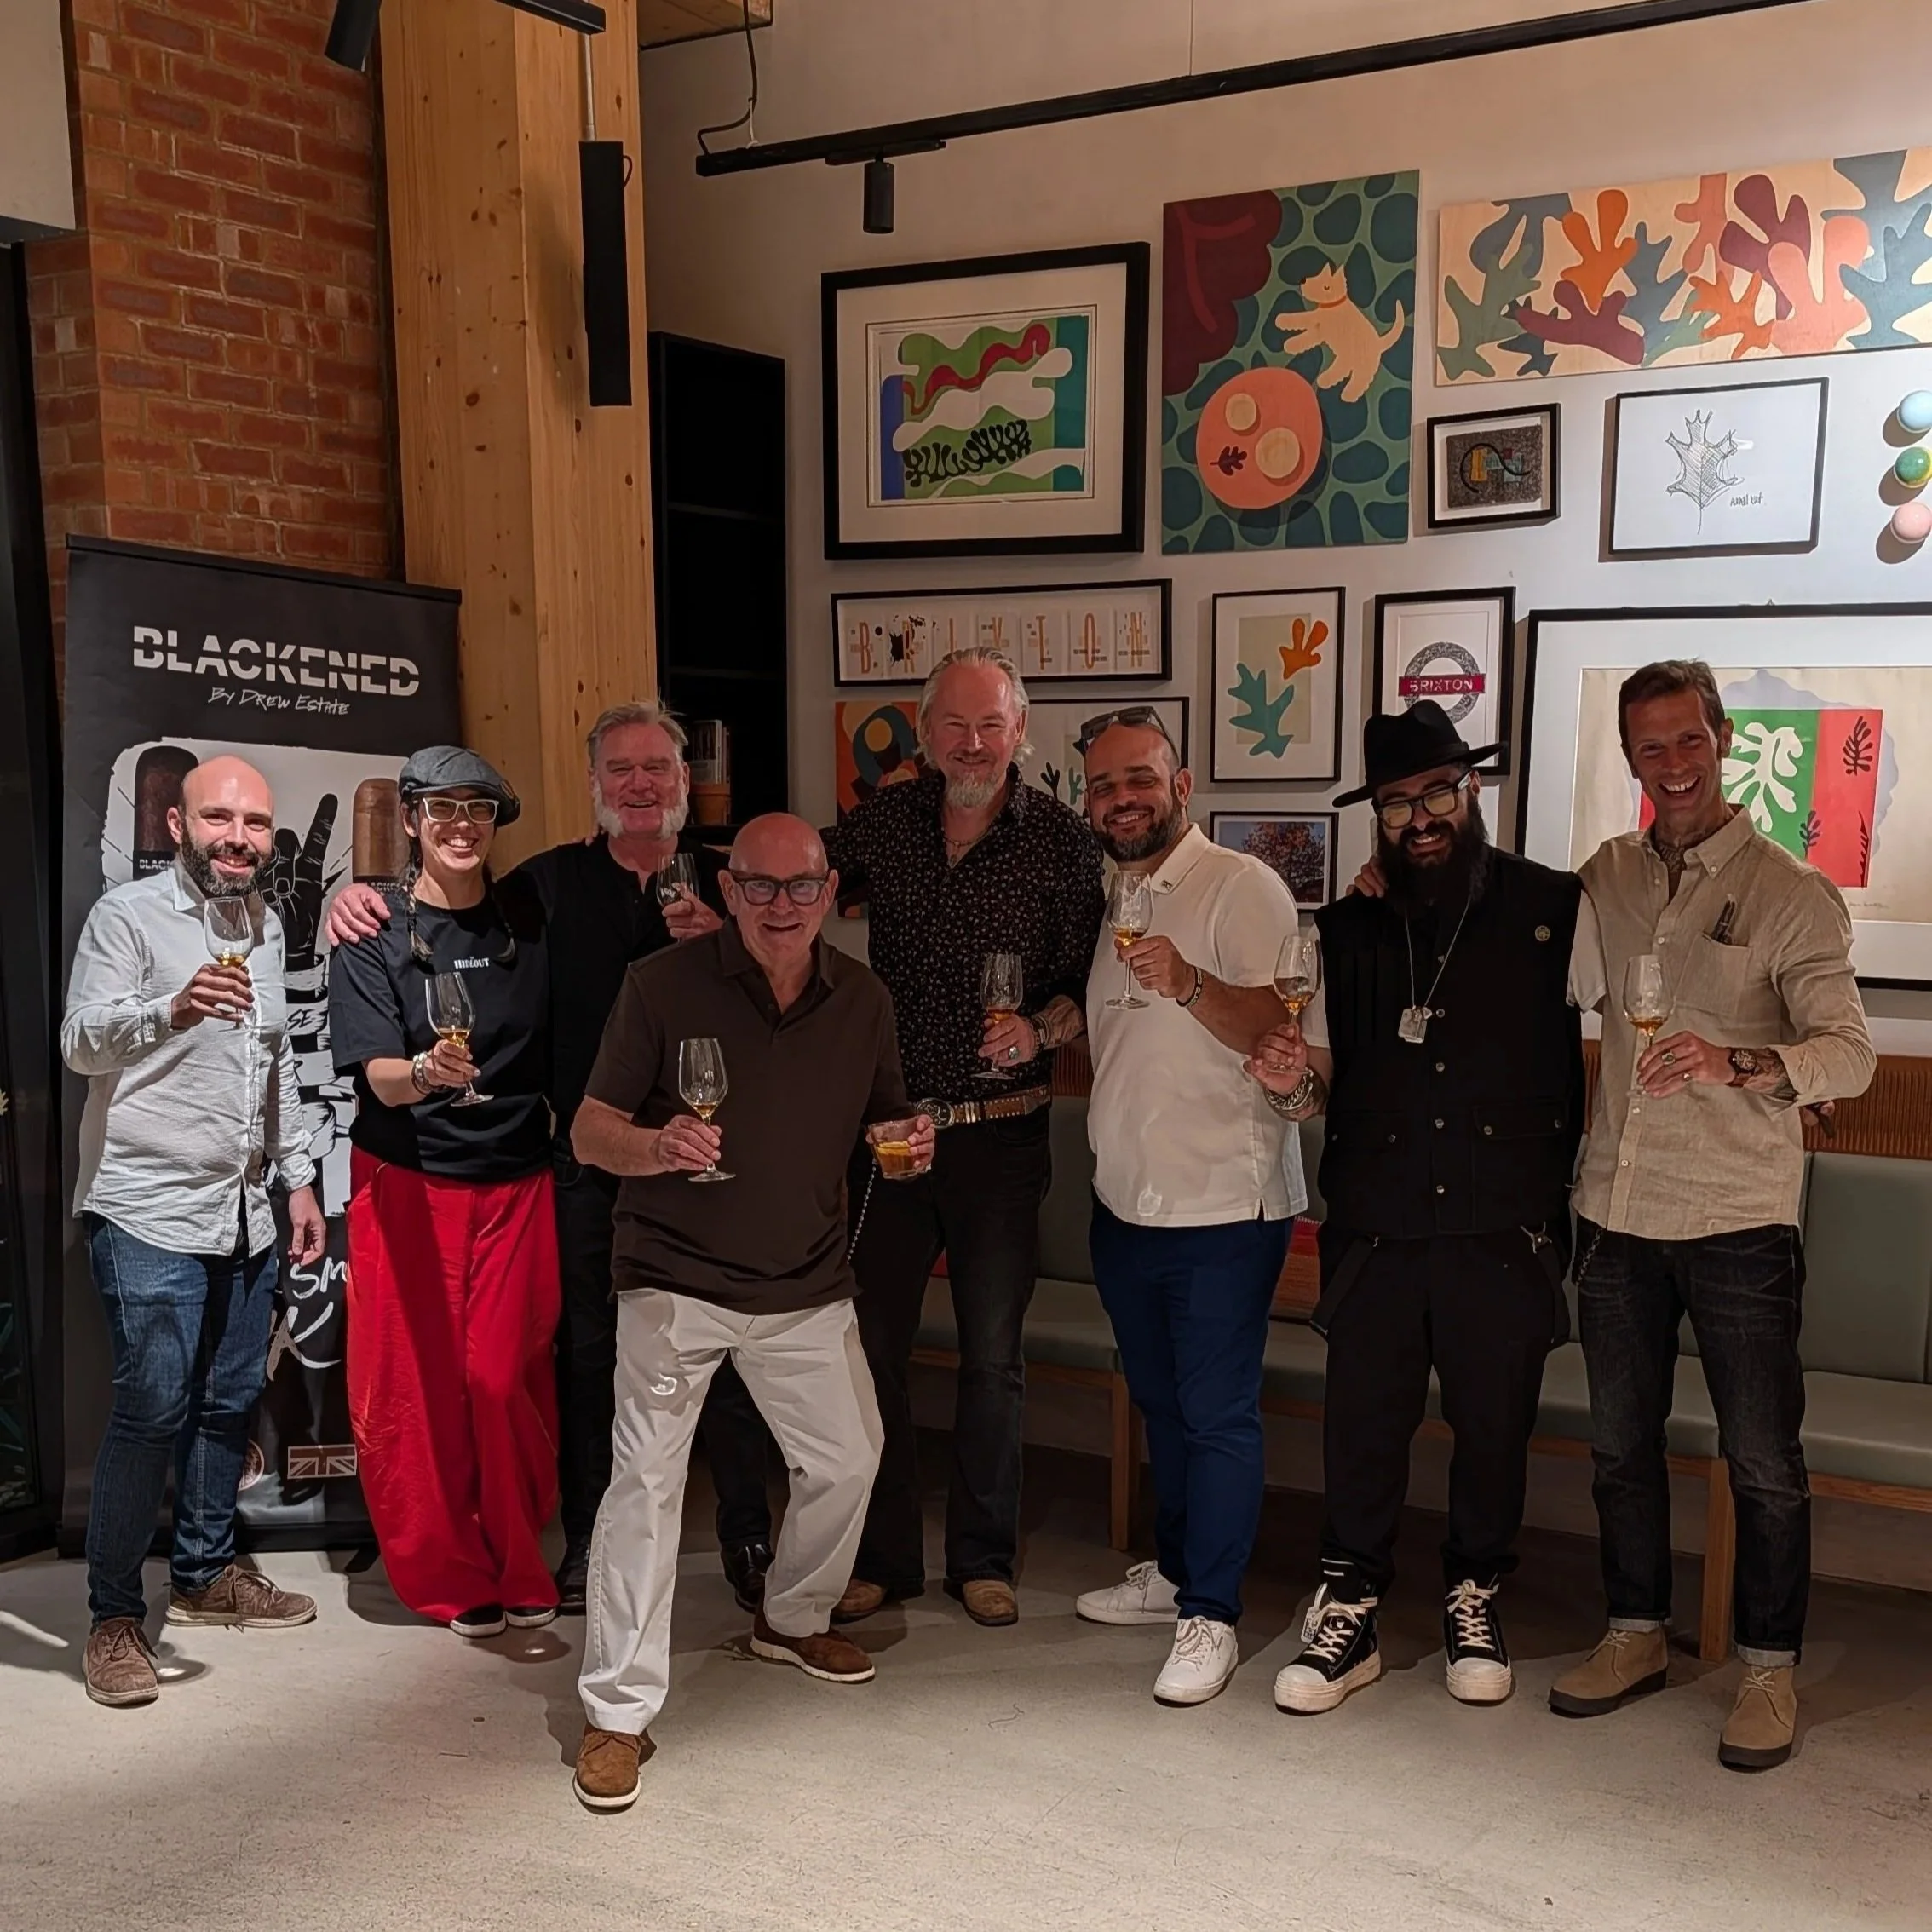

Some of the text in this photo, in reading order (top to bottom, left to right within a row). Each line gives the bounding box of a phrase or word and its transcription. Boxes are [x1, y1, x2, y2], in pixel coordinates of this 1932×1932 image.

[133, 625, 420, 697] BLACKENED
[1409, 678, 1474, 692] BRIXTON
[208, 687, 235, 706] By
